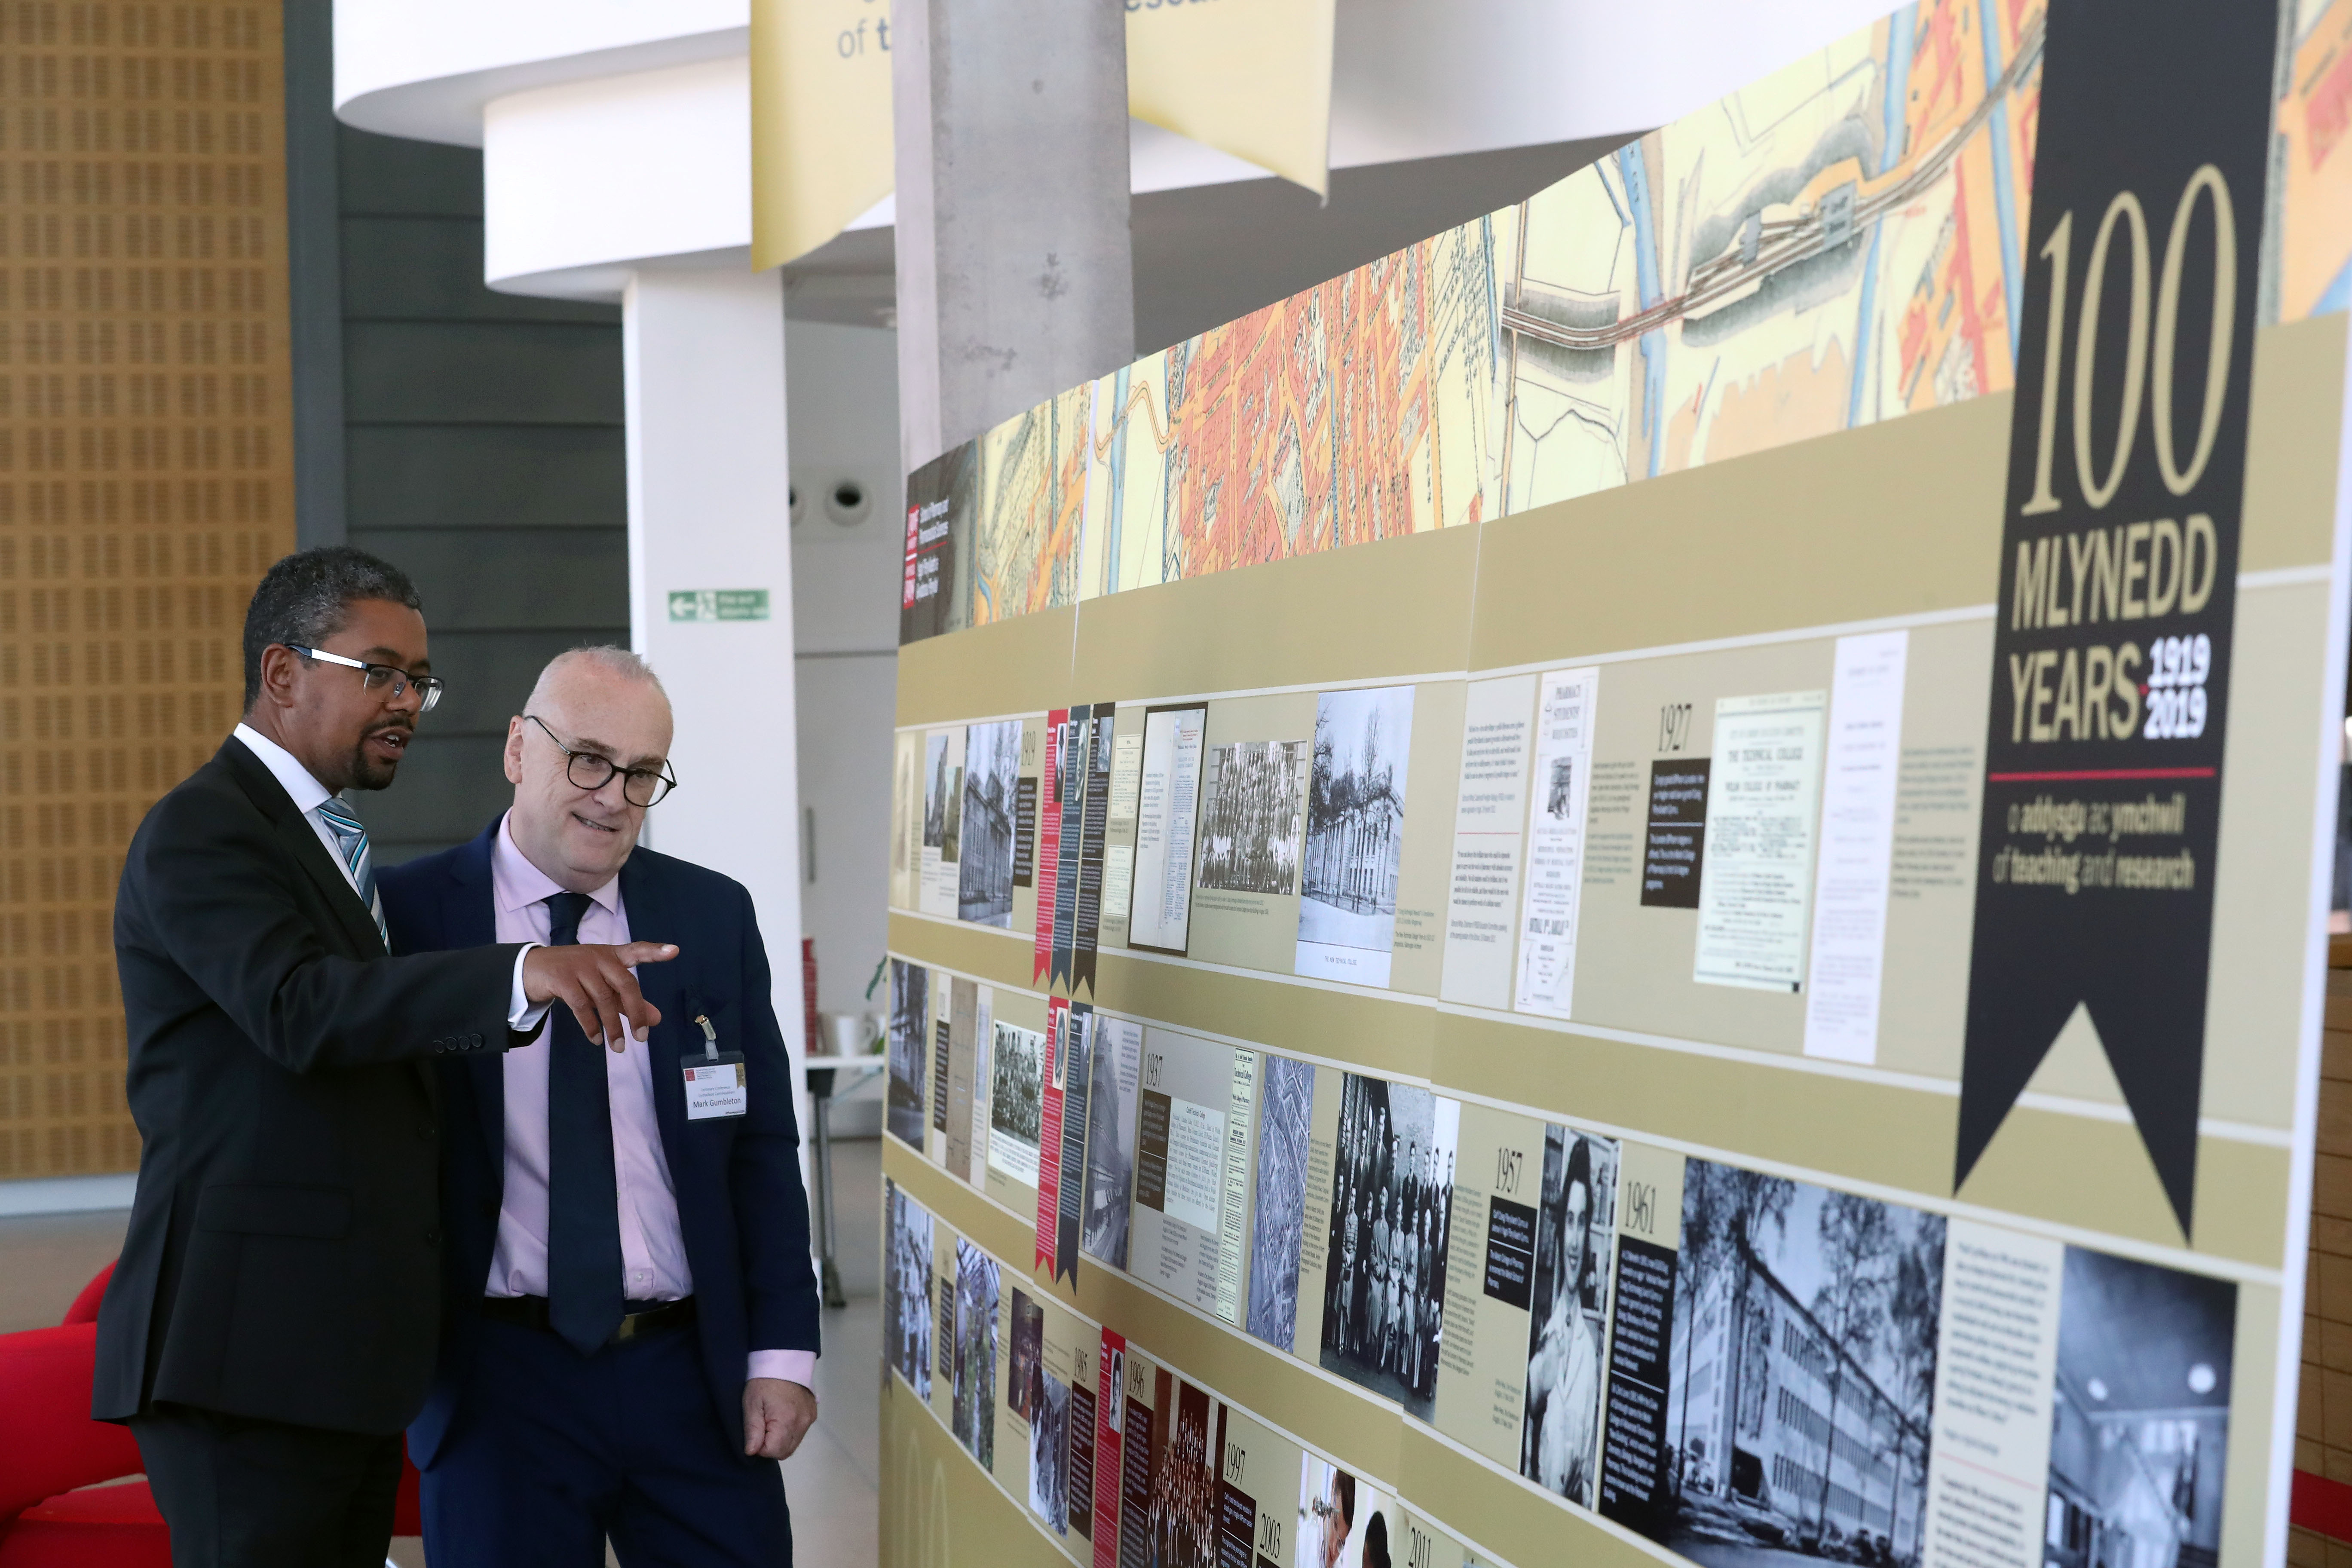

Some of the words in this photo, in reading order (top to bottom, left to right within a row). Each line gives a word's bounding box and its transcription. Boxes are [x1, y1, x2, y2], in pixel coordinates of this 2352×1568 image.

[837, 19, 867, 58] of
[2021, 162, 2236, 516] 100
[2012, 513, 2218, 631] MLYNEDD
[2009, 641, 2141, 744] YEARS
[2148, 633, 2211, 688] 1919
[1658, 703, 1693, 752] 1927
[2143, 687, 2207, 740] 2019
[2010, 845, 2081, 895] teaching
[2115, 847, 2195, 890] research
[1146, 1053, 1163, 1088] 1937
[693, 1100, 708, 1108] Mark
[710, 1098, 741, 1106] Gumbleton
[1495, 1147, 1523, 1195] 1957
[1625, 1180, 1656, 1234] 1961
[1074, 1346, 1088, 1383] 1985
[1129, 1360, 1145, 1398] 1996
[1226, 1442, 1246, 1485] 1997
[1259, 1513, 1281, 1559] 2003
[1408, 1526, 1431, 1568] 2011
